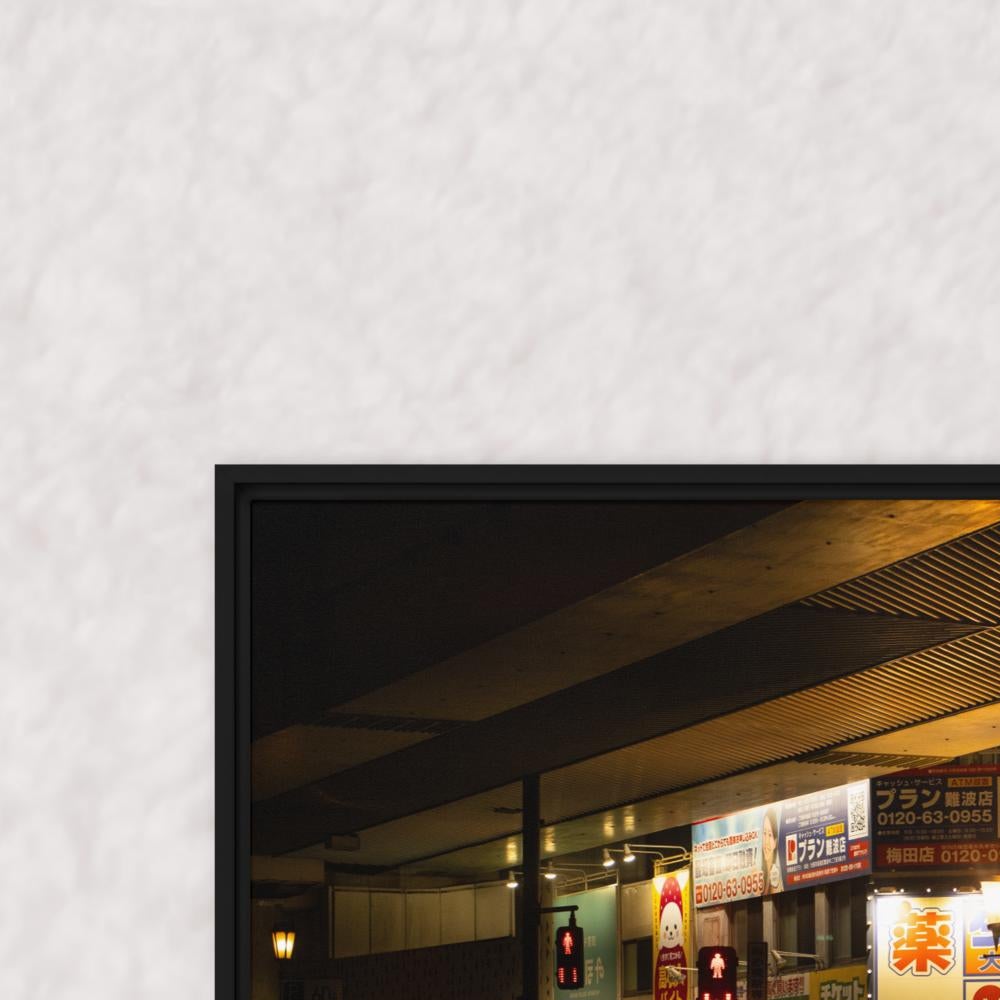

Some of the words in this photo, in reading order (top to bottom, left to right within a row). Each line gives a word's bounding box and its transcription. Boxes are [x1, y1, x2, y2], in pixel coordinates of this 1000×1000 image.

[876, 788, 941, 810] プラン
[944, 790, 993, 808] 難波店
[877, 809, 992, 826] 0120-63-0955
[798, 838, 824, 862] プラン
[886, 846, 935, 864] 梅田店
[702, 871, 765, 902] 0120-63-0955
[891, 908, 954, 974] 薬
